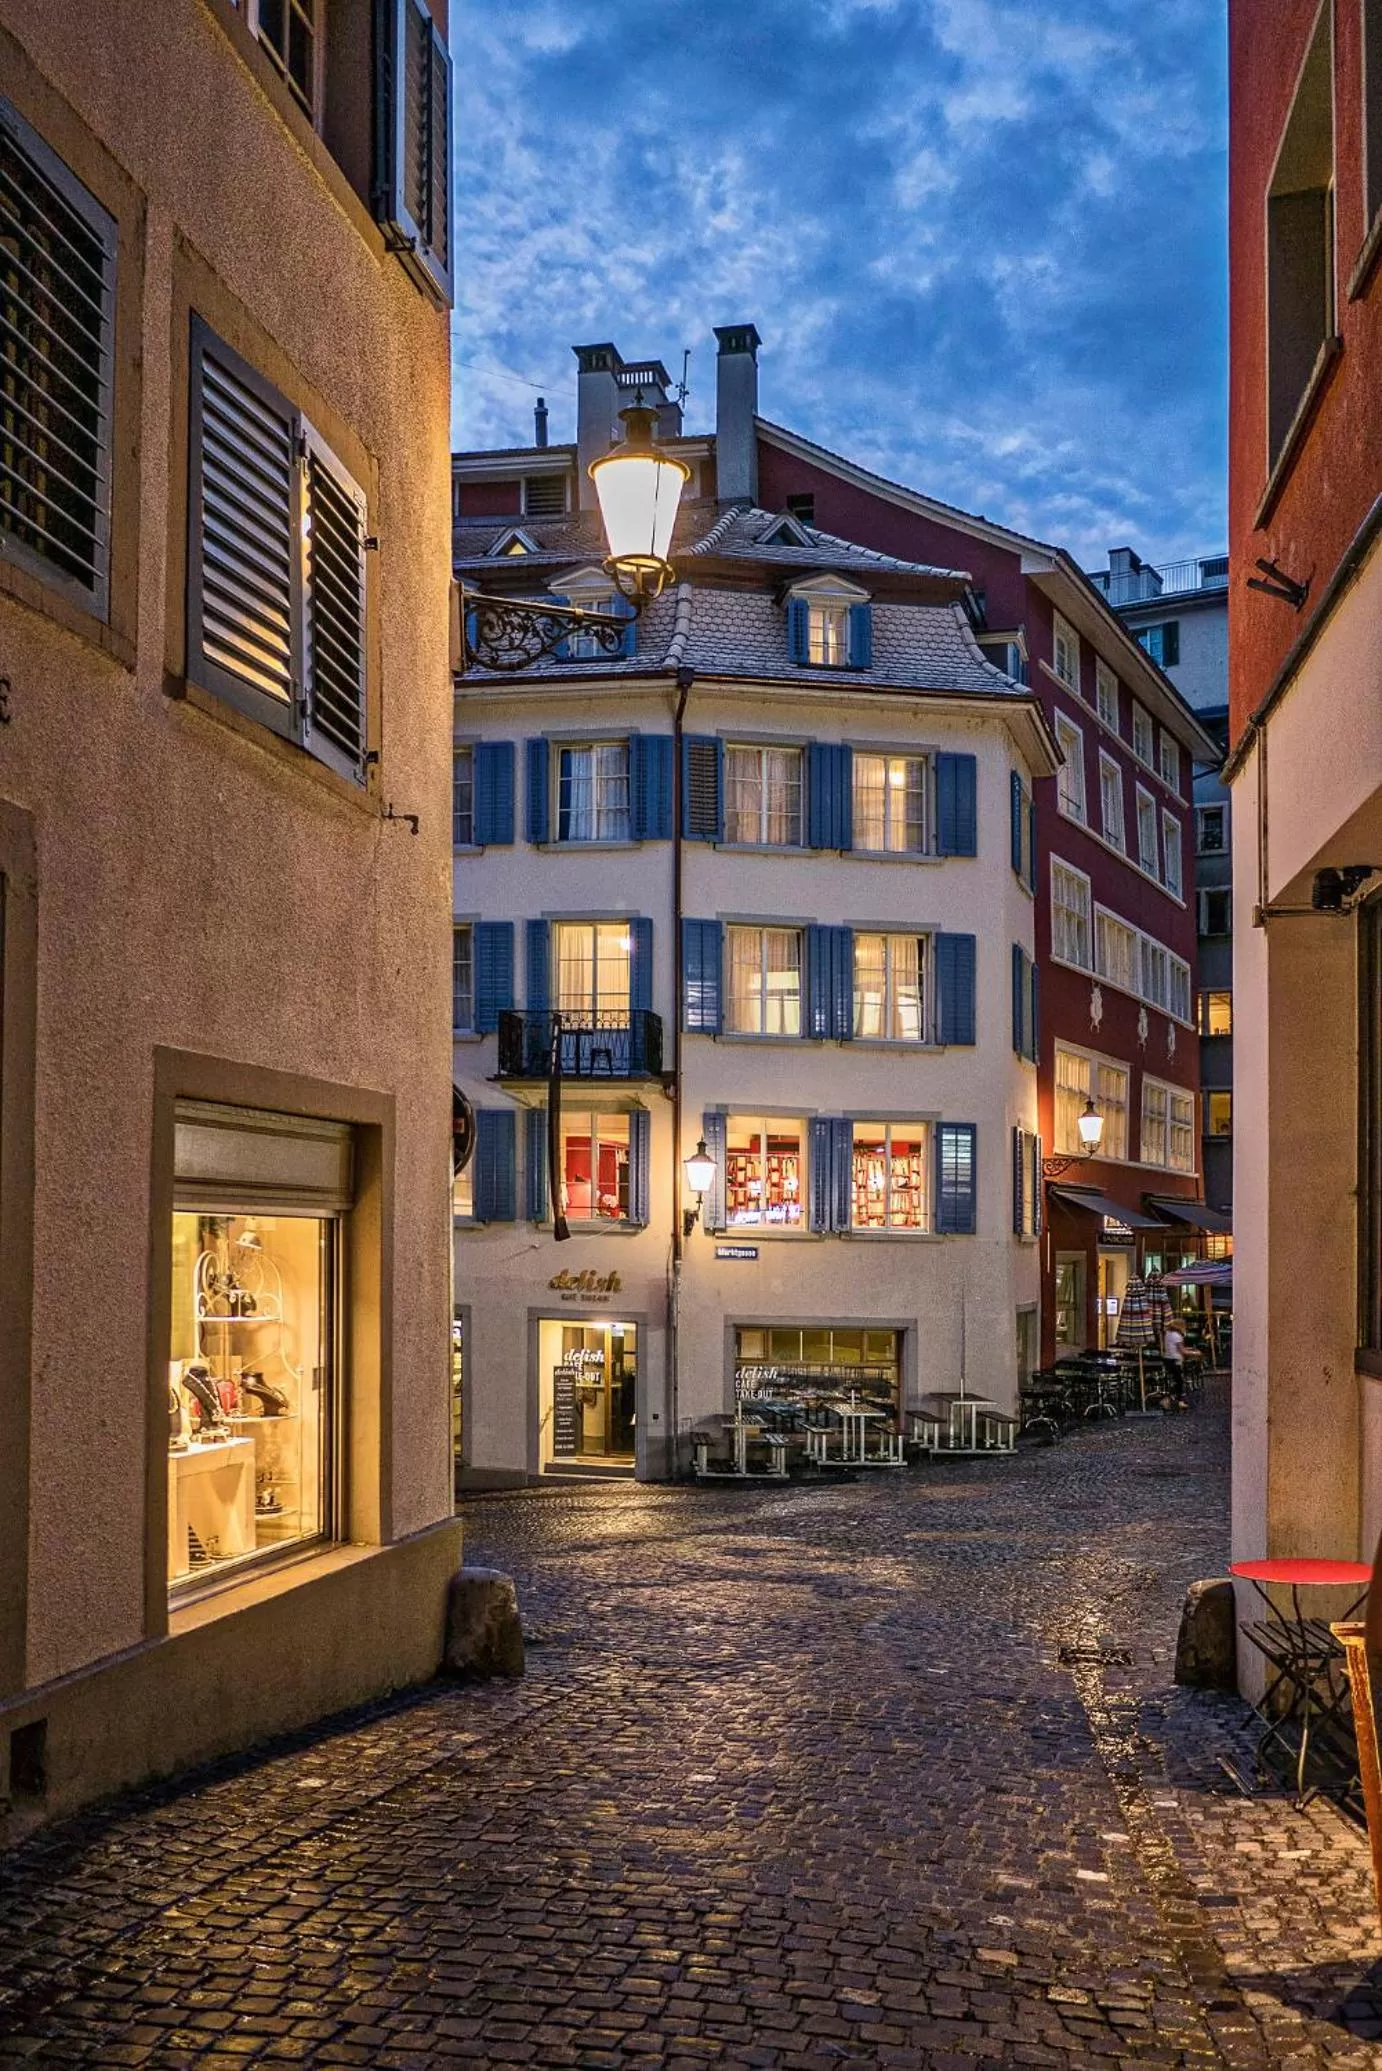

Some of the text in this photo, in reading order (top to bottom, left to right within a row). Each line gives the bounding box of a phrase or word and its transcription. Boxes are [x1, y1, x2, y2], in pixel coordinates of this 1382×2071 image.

[548, 1268, 622, 1293] delish
[564, 1348, 605, 1363] delish
[736, 1365, 778, 1379] delish
[735, 1388, 774, 1400] TAKE-OUT
